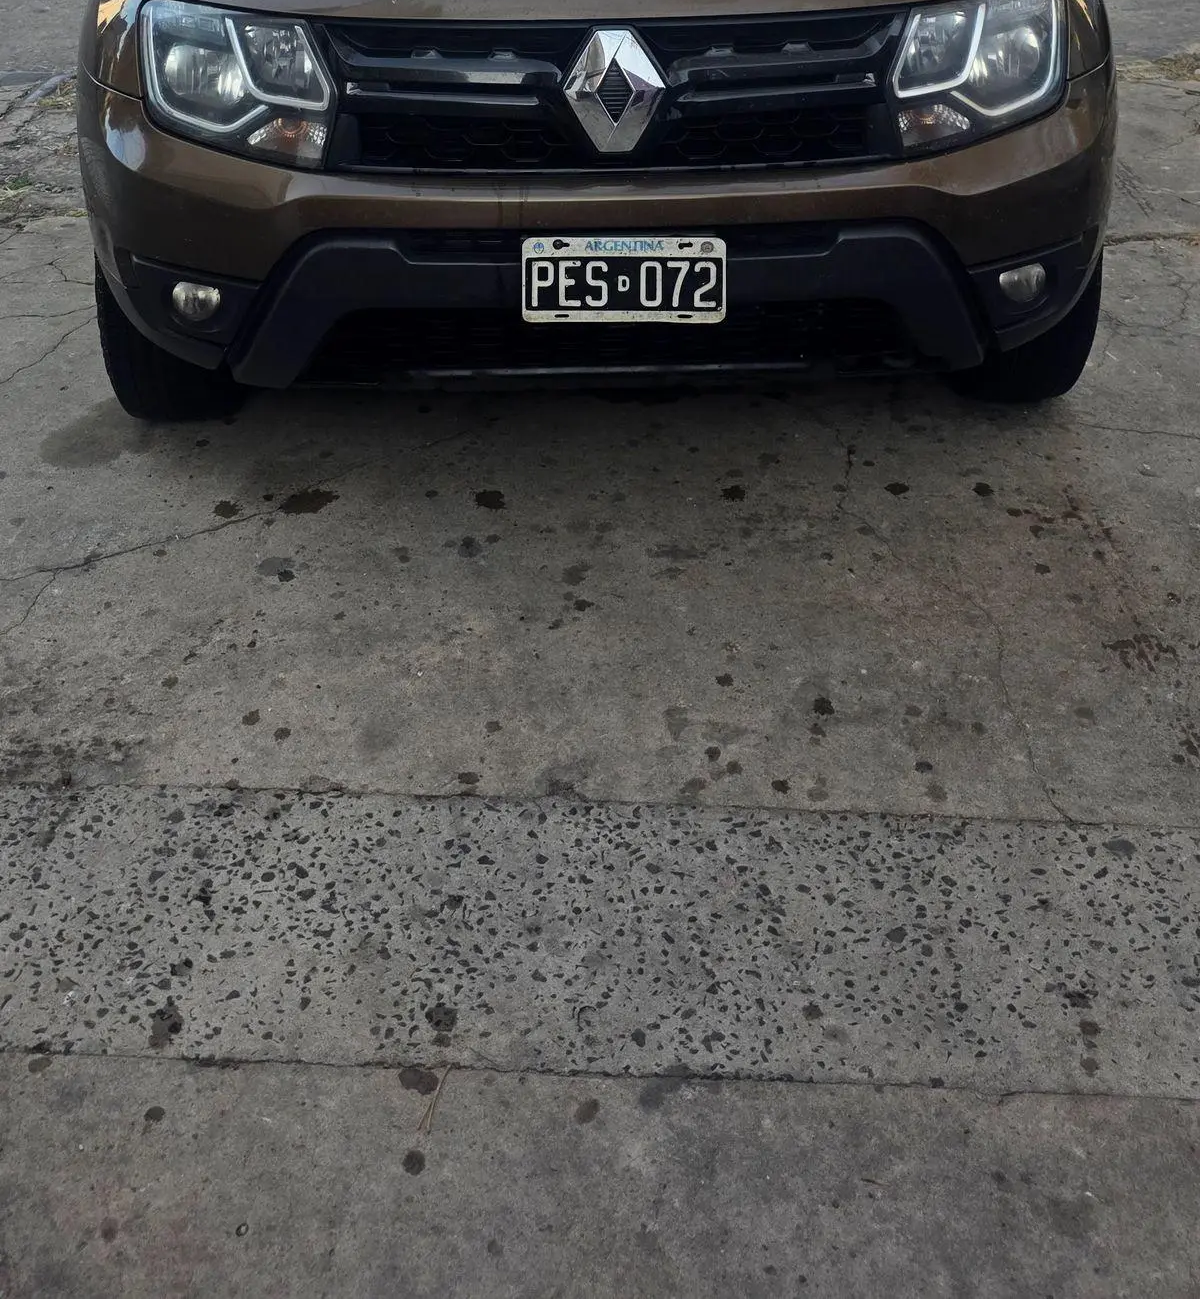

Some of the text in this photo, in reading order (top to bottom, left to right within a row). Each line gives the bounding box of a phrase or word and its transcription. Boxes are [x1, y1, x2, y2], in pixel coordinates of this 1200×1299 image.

[584, 239, 665, 252] ARGENTINA
[531, 260, 717, 307] PES D 072
